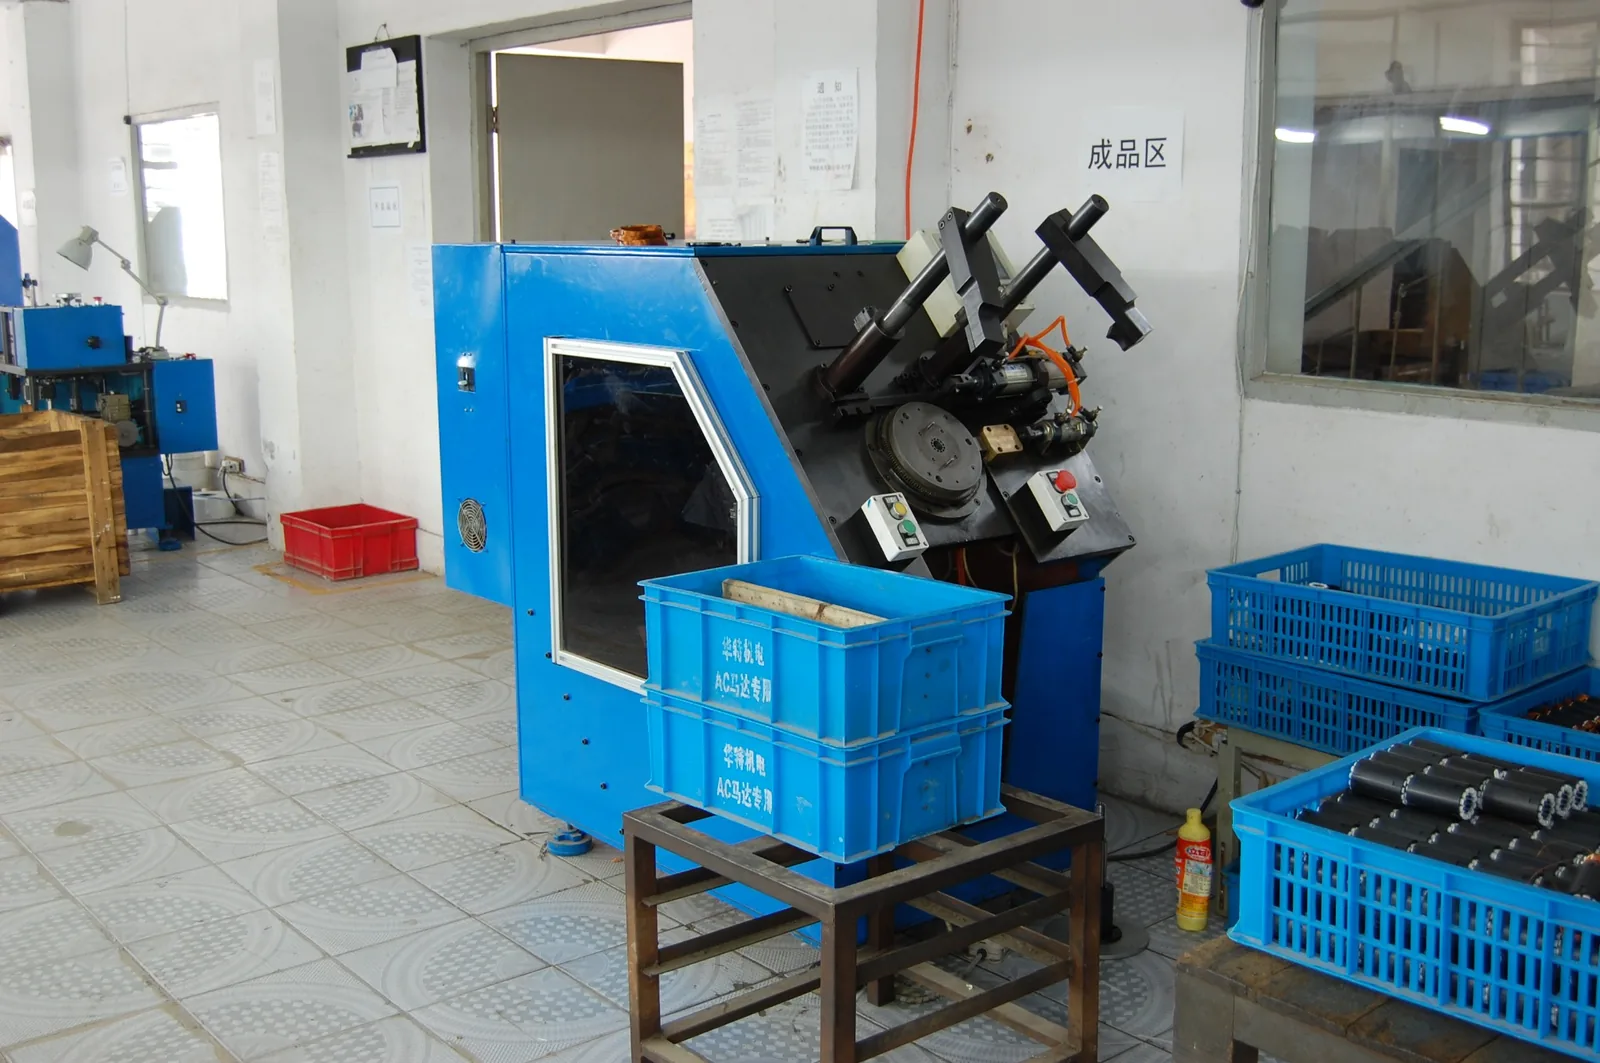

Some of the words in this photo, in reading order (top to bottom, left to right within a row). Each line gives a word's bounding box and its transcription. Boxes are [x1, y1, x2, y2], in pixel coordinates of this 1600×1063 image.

[1088, 138, 1167, 169] 成品区
[715, 671, 771, 703] AC马达专用
[723, 743, 766, 777] 华特机电
[716, 777, 772, 815] AC马达专用
